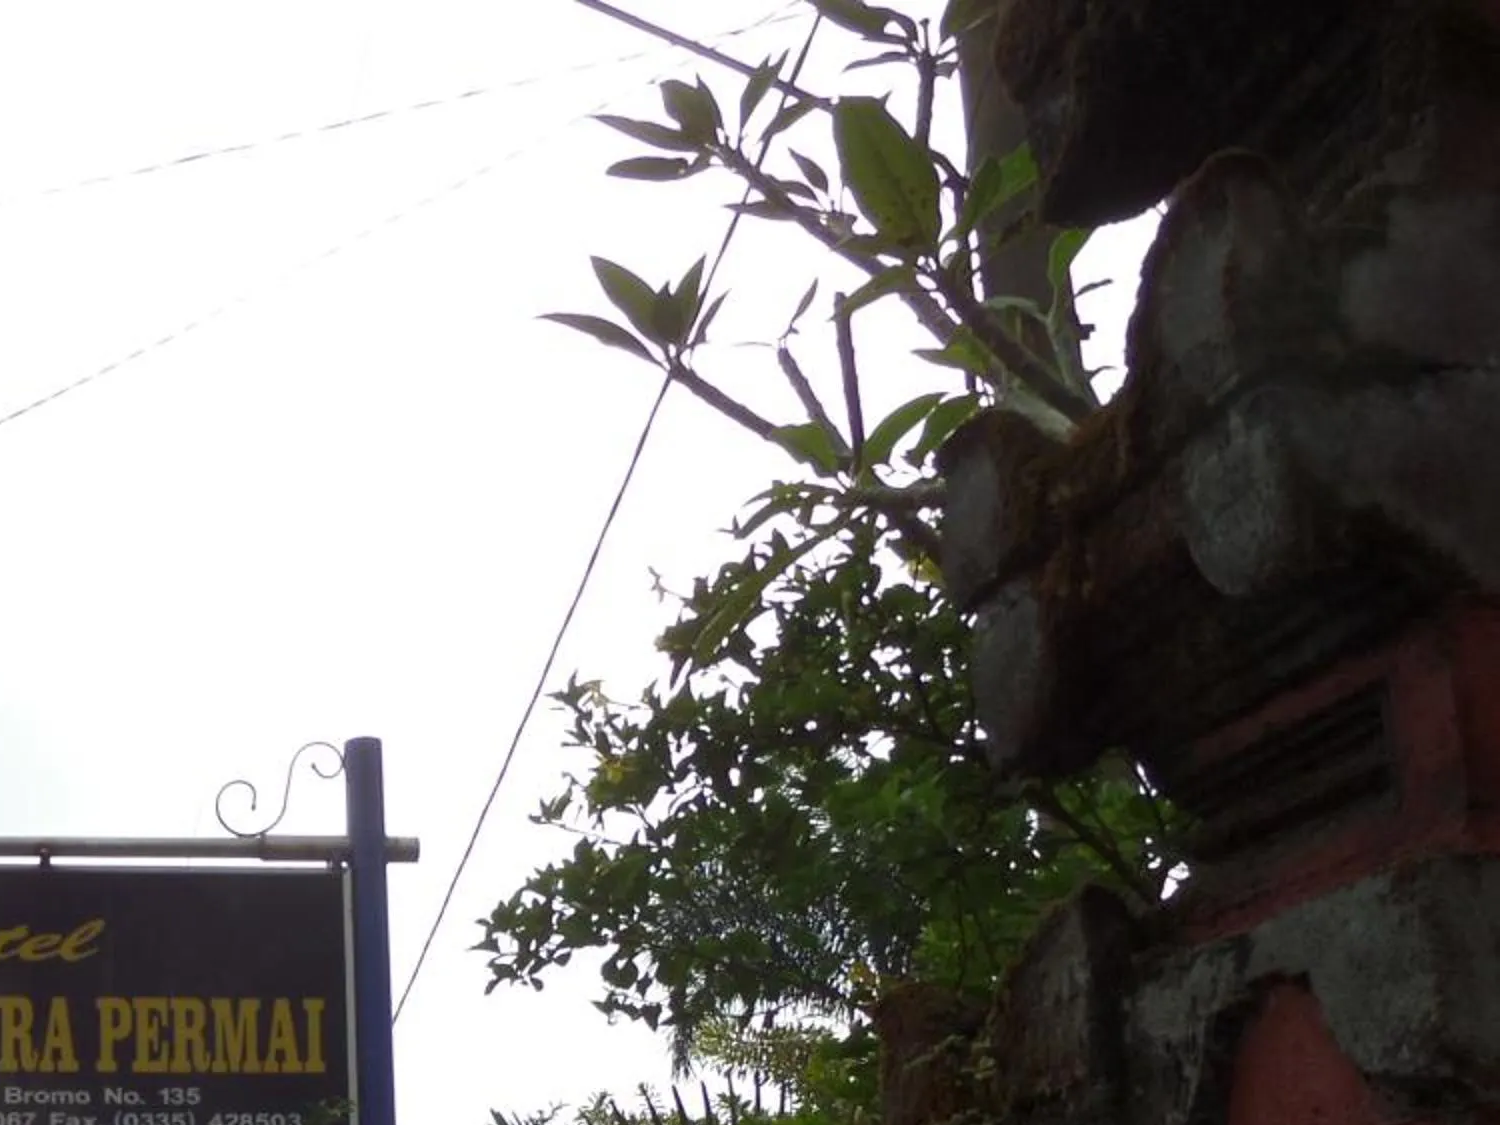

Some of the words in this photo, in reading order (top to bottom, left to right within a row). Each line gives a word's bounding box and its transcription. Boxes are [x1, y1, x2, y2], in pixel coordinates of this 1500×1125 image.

[95, 995, 326, 1074] PERMAI
[4, 1086, 91, 1105] Bromo
[104, 1087, 146, 1105] No.
[159, 1087, 201, 1106] 135
